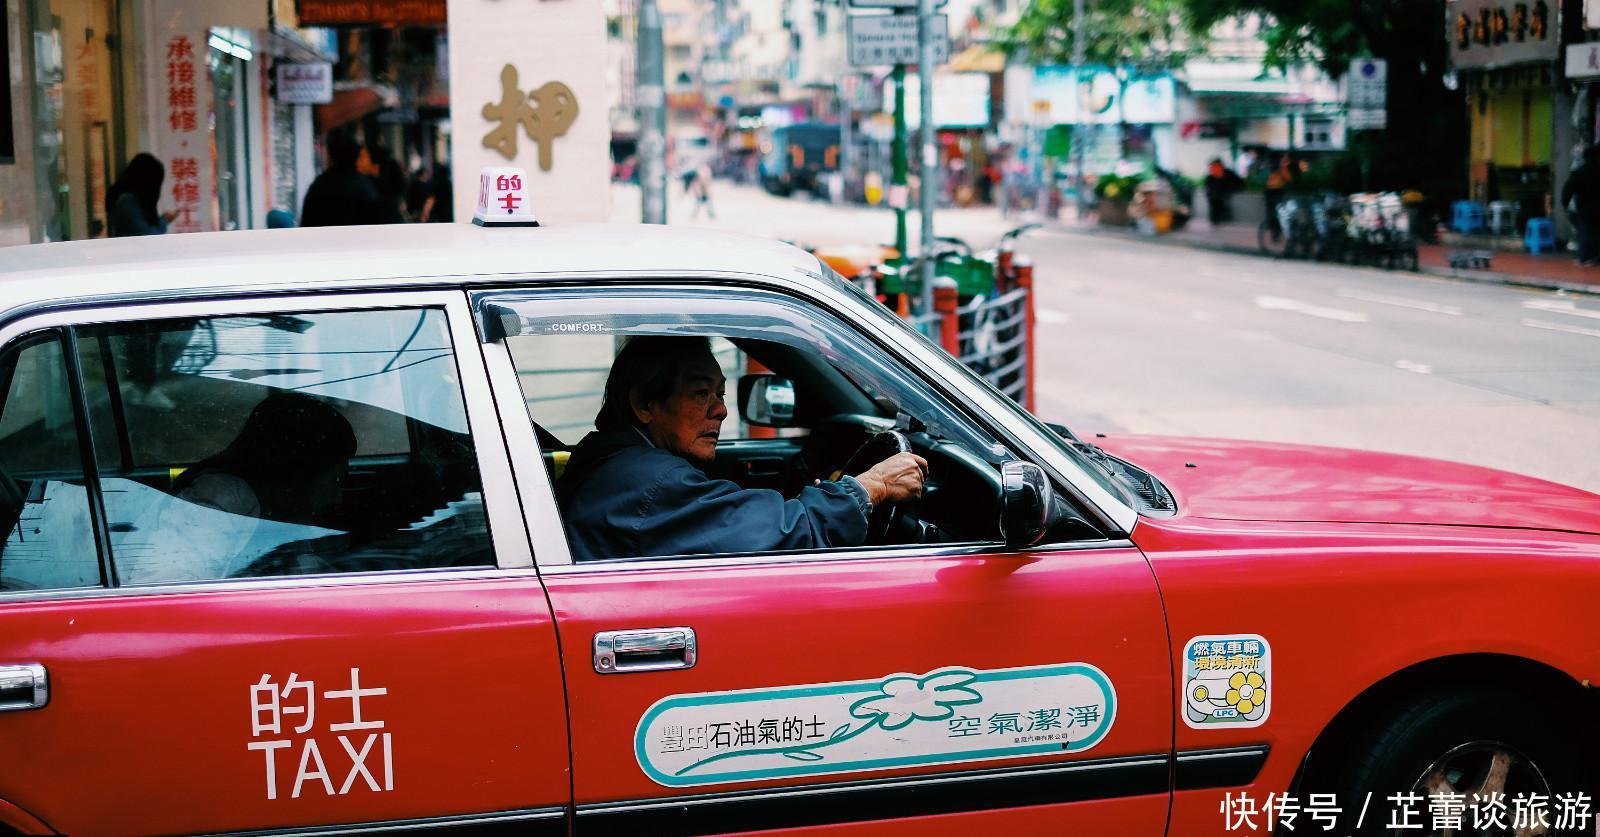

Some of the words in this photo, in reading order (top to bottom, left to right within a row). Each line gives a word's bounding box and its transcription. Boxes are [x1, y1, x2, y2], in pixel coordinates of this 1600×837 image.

[482, 64, 579, 172] 押
[497, 175, 522, 209] 的士
[552, 323, 603, 332] COMFORT
[1193, 641, 1260, 656] 燃氣車輛
[250, 668, 387, 736] 的士
[948, 704, 1100, 738] 空氣潔淨
[248, 733, 394, 800] TAXI
